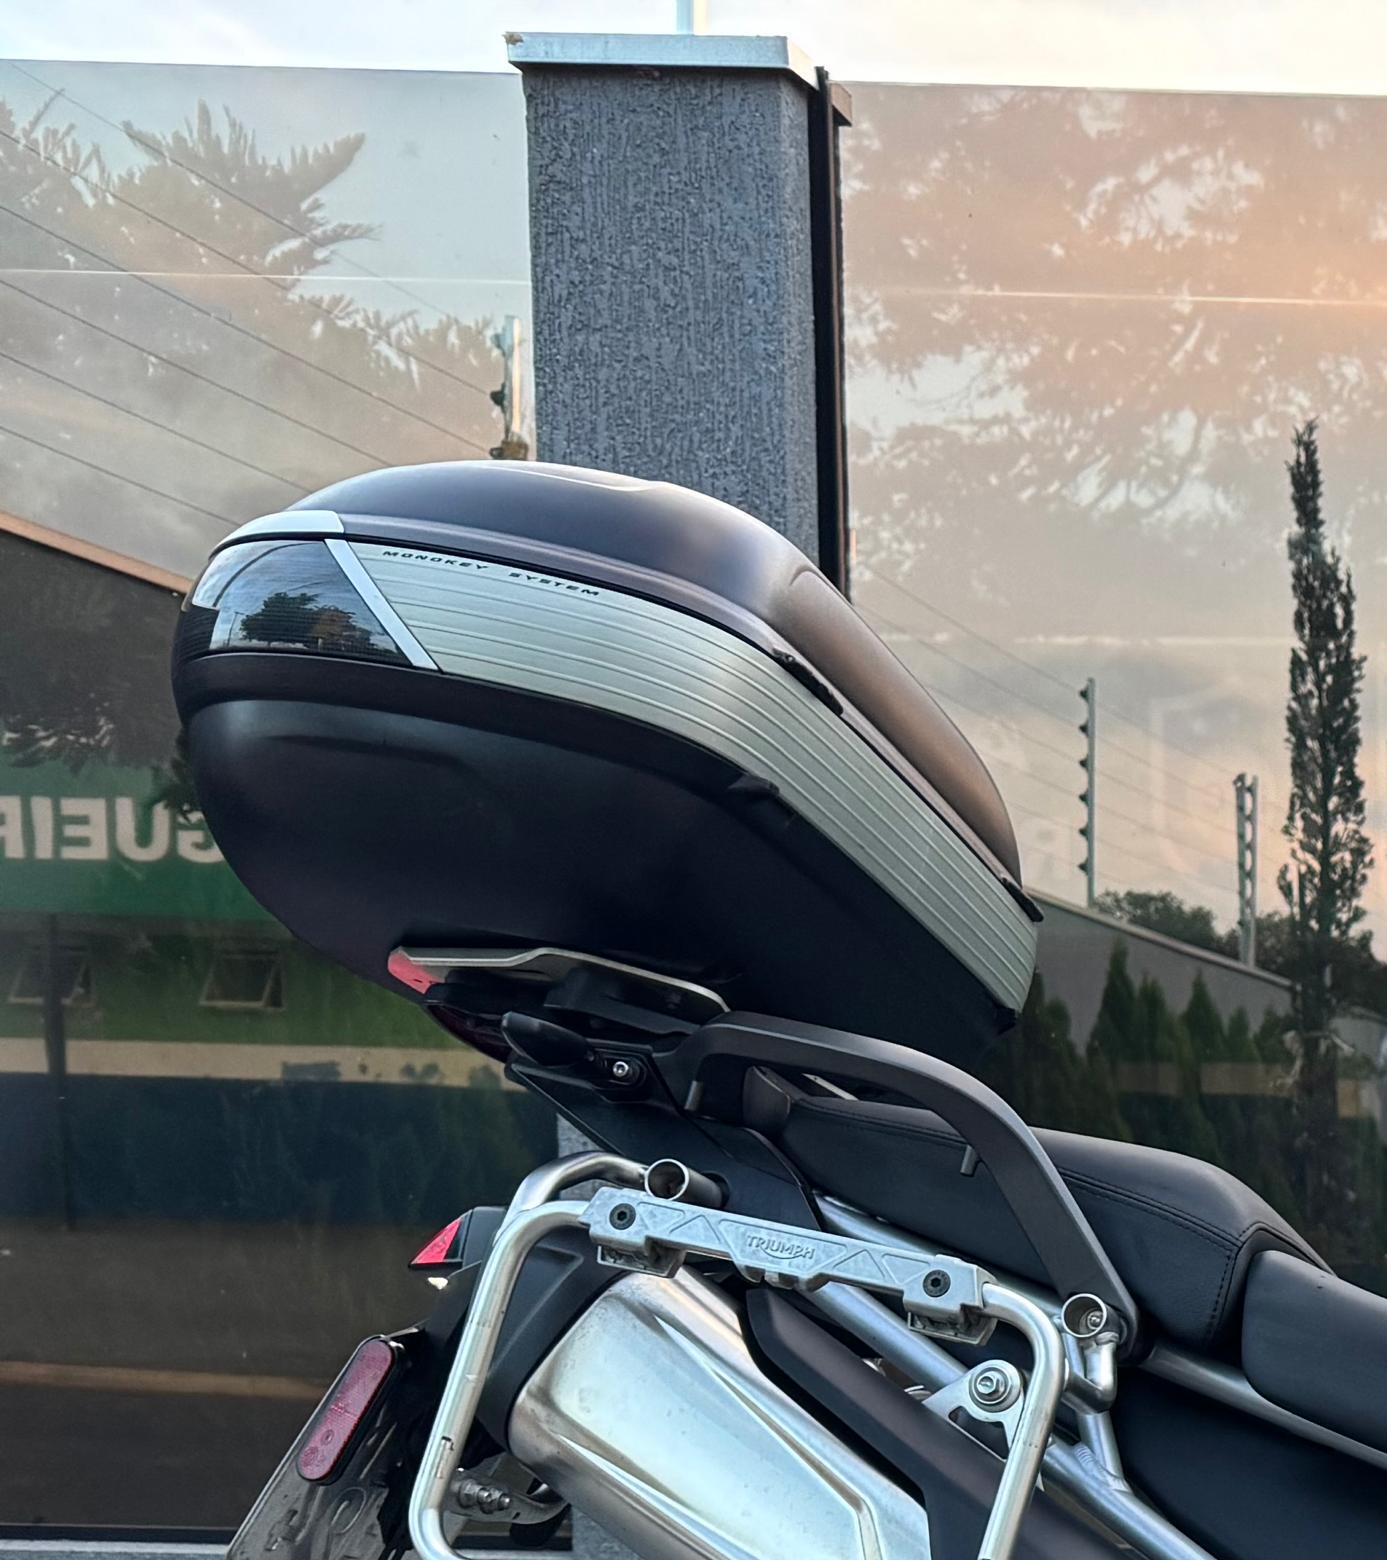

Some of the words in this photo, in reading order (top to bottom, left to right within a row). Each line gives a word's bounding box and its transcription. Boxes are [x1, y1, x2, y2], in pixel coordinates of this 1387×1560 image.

[383, 550, 489, 571] MONOKEY
[508, 572, 601, 597] SYSTEM
[745, 1233, 816, 1261] TRIUMPH
